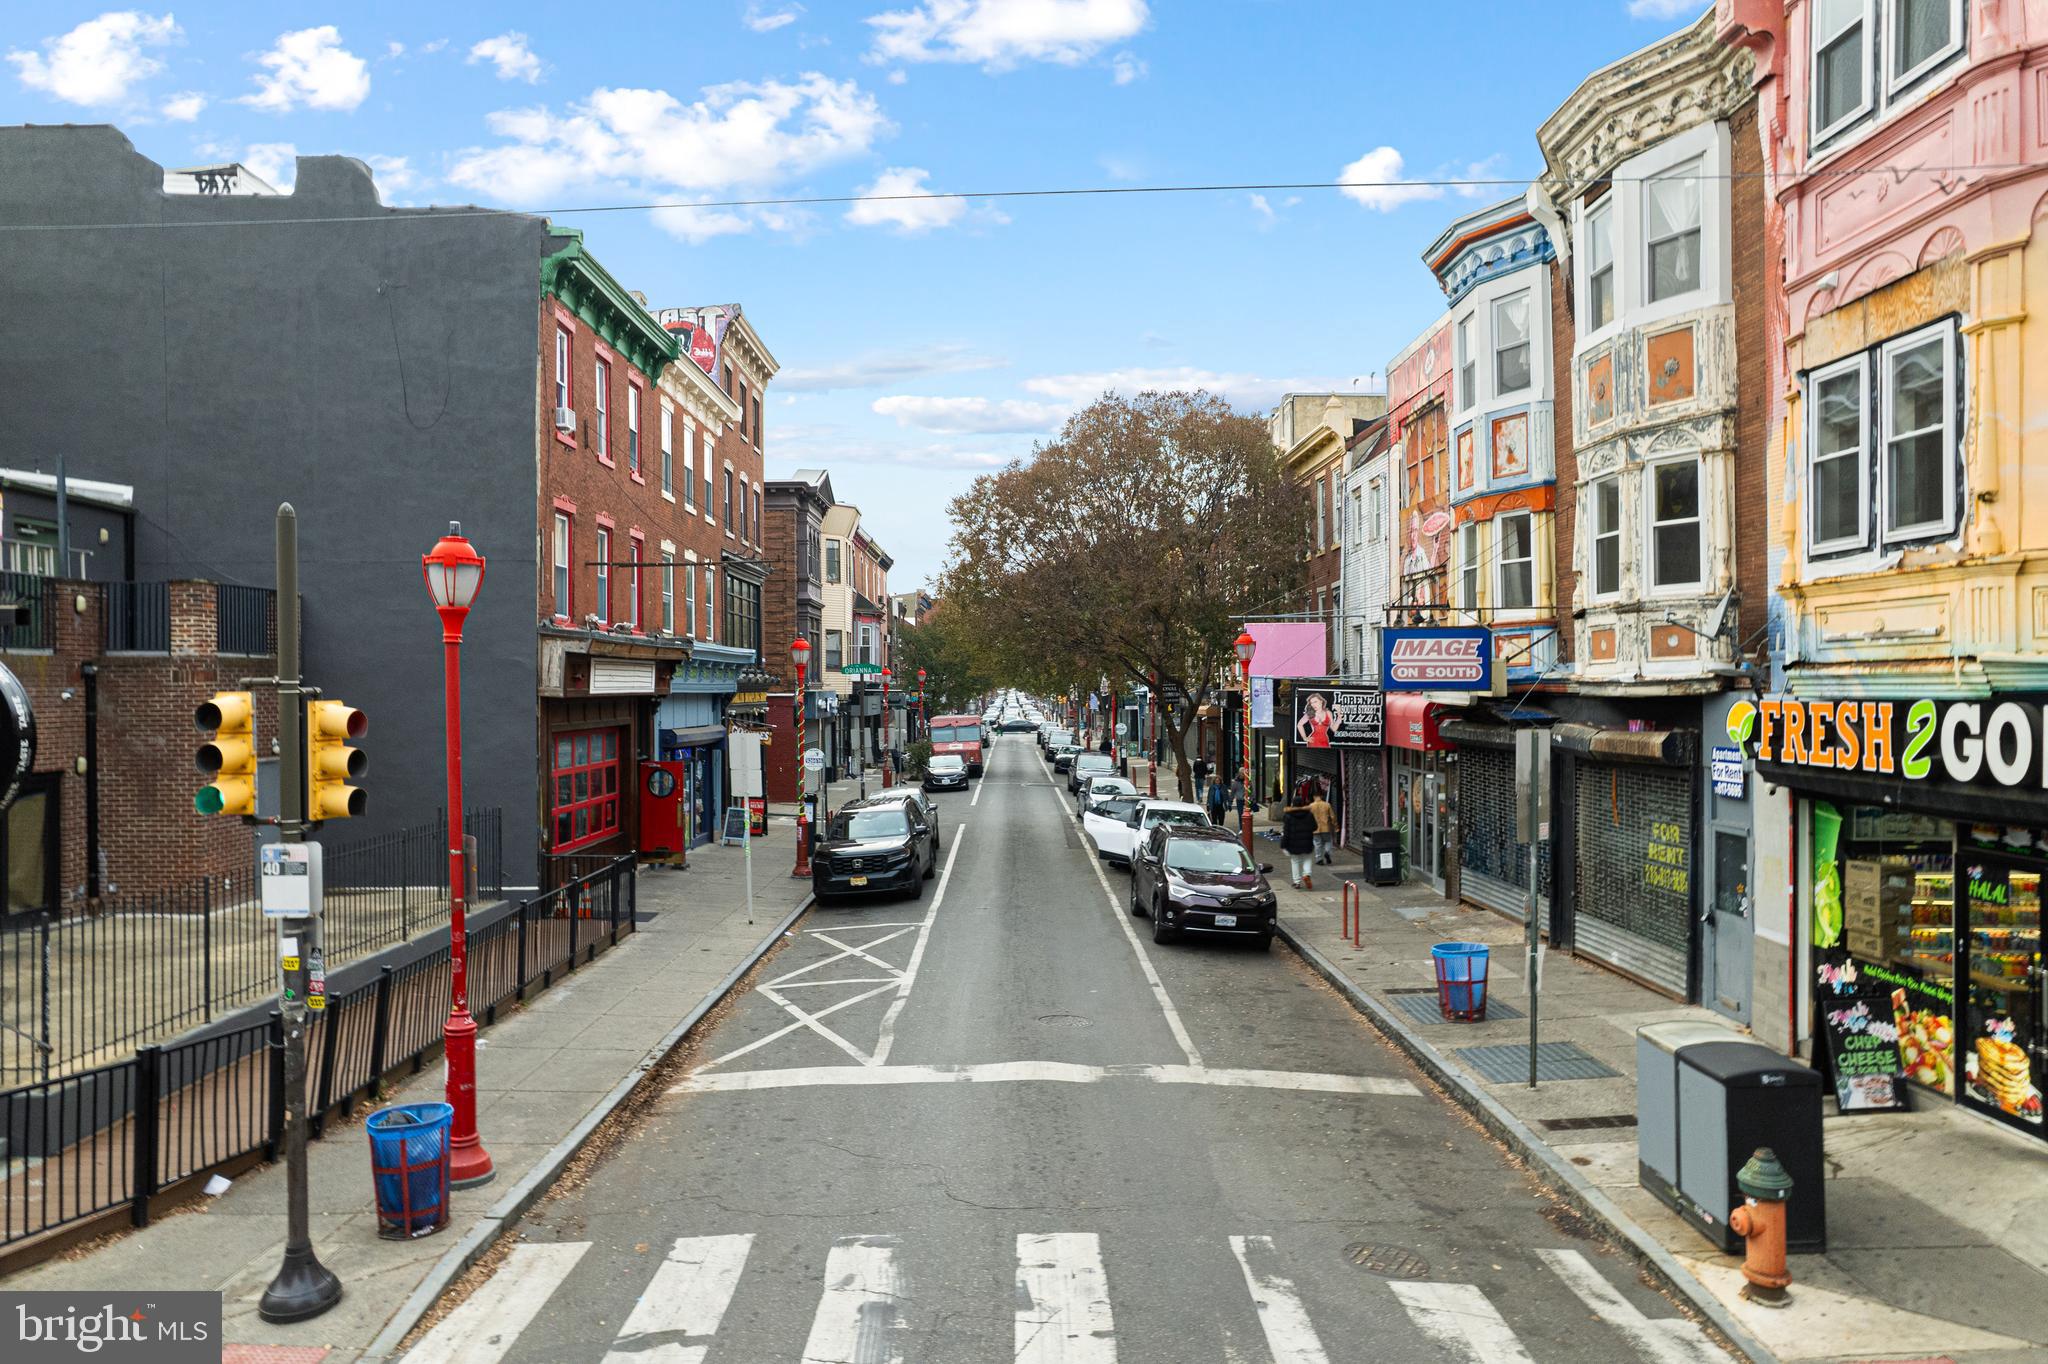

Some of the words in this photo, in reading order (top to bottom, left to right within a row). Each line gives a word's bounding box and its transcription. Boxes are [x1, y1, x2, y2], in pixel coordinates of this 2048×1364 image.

[1393, 640, 1481, 656] IMAGE
[1397, 667, 1419, 678] ON
[1425, 667, 1477, 678] SOUTH
[1757, 699, 1895, 774] FRESH
[1901, 698, 1937, 780] 2
[1712, 747, 1742, 762] Apartment
[1712, 765, 1724, 778] For
[1725, 766, 1742, 780] Rent
[1652, 822, 1681, 844] FOR
[1648, 842, 1685, 865] RENT
[264, 862, 281, 876] 40
[1968, 879, 2007, 904] HALAL
[1838, 1049, 1897, 1067] CHEESE
